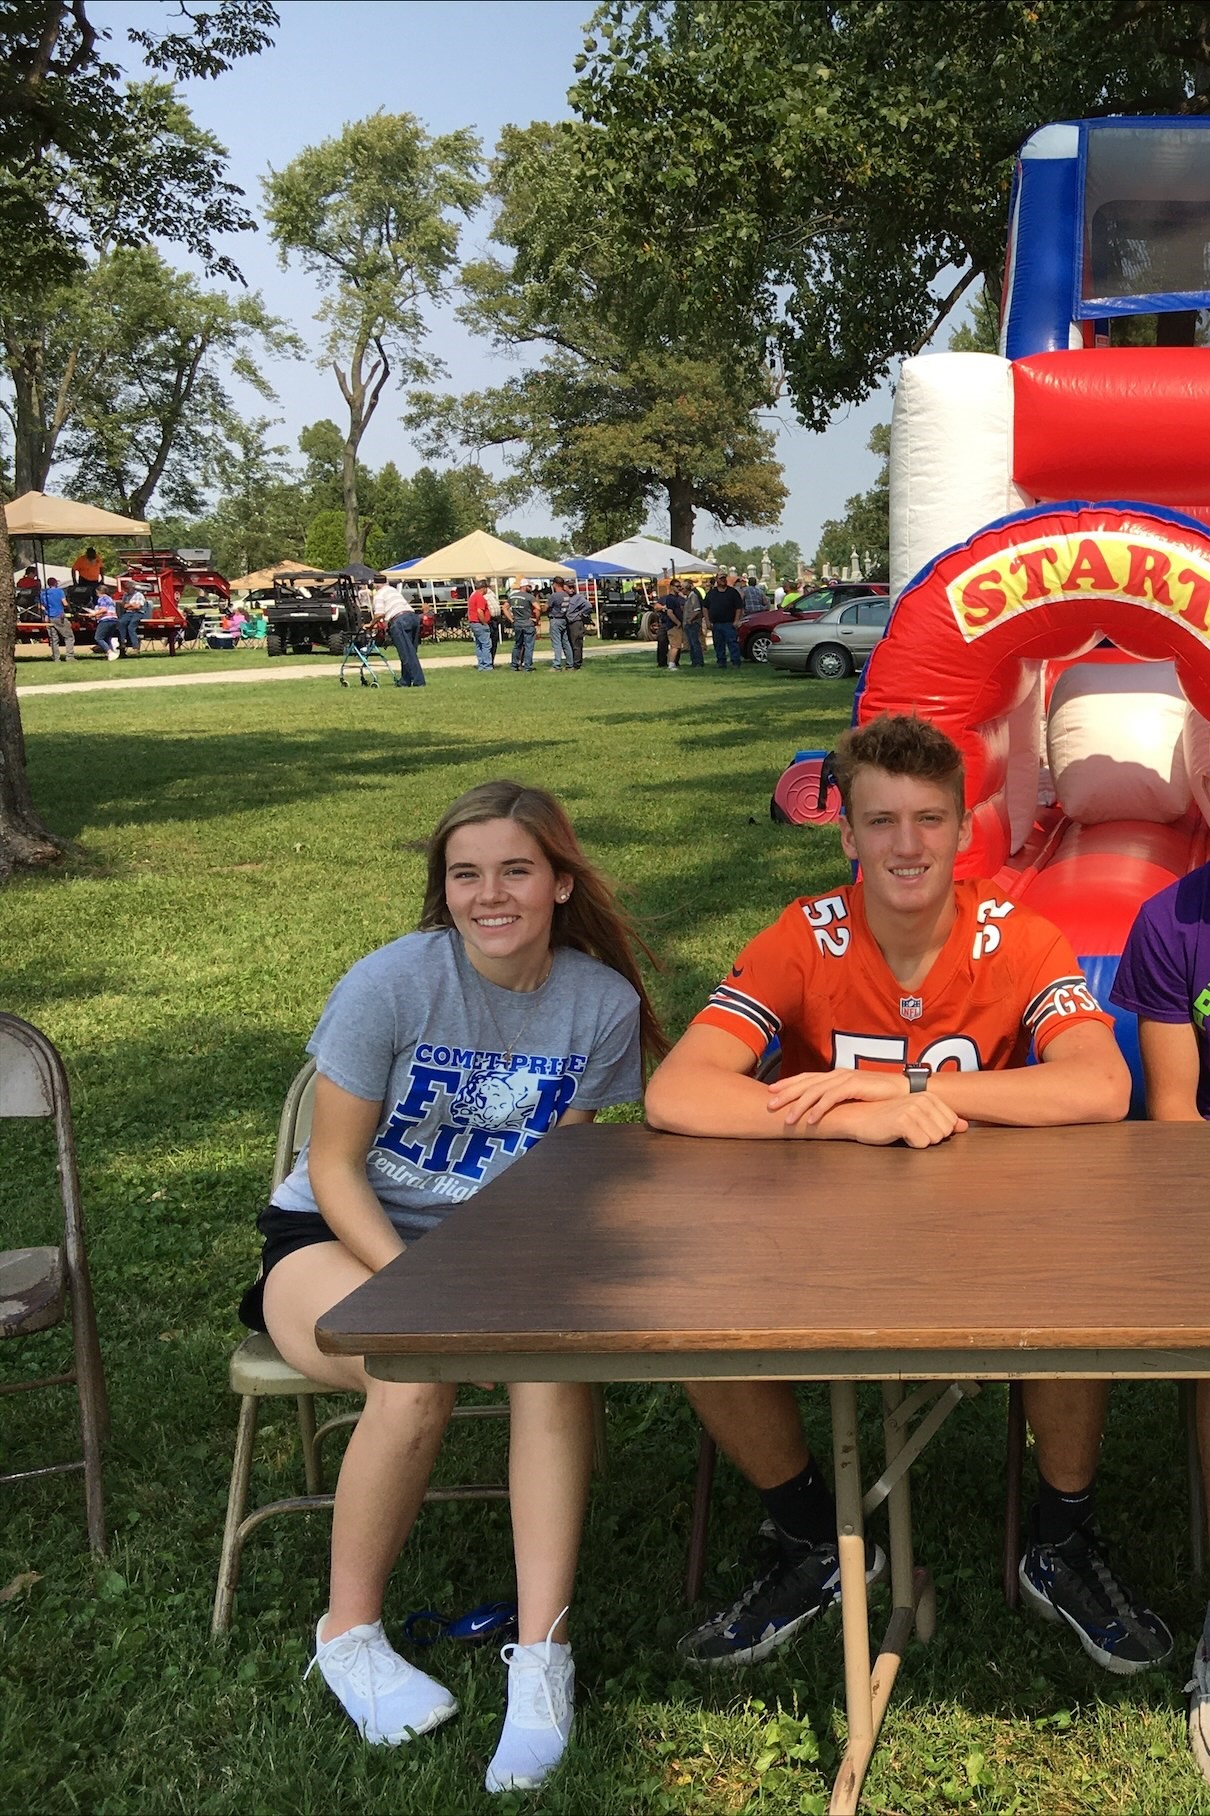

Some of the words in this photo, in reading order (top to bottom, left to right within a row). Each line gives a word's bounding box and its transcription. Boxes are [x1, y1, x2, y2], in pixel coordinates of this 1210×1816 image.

[802, 895, 851, 959] 52
[903, 1007, 920, 1018] NFL
[1053, 984, 1102, 1017] GS
[414, 1043, 502, 1071] COMET
[366, 1150, 433, 1190] Central
